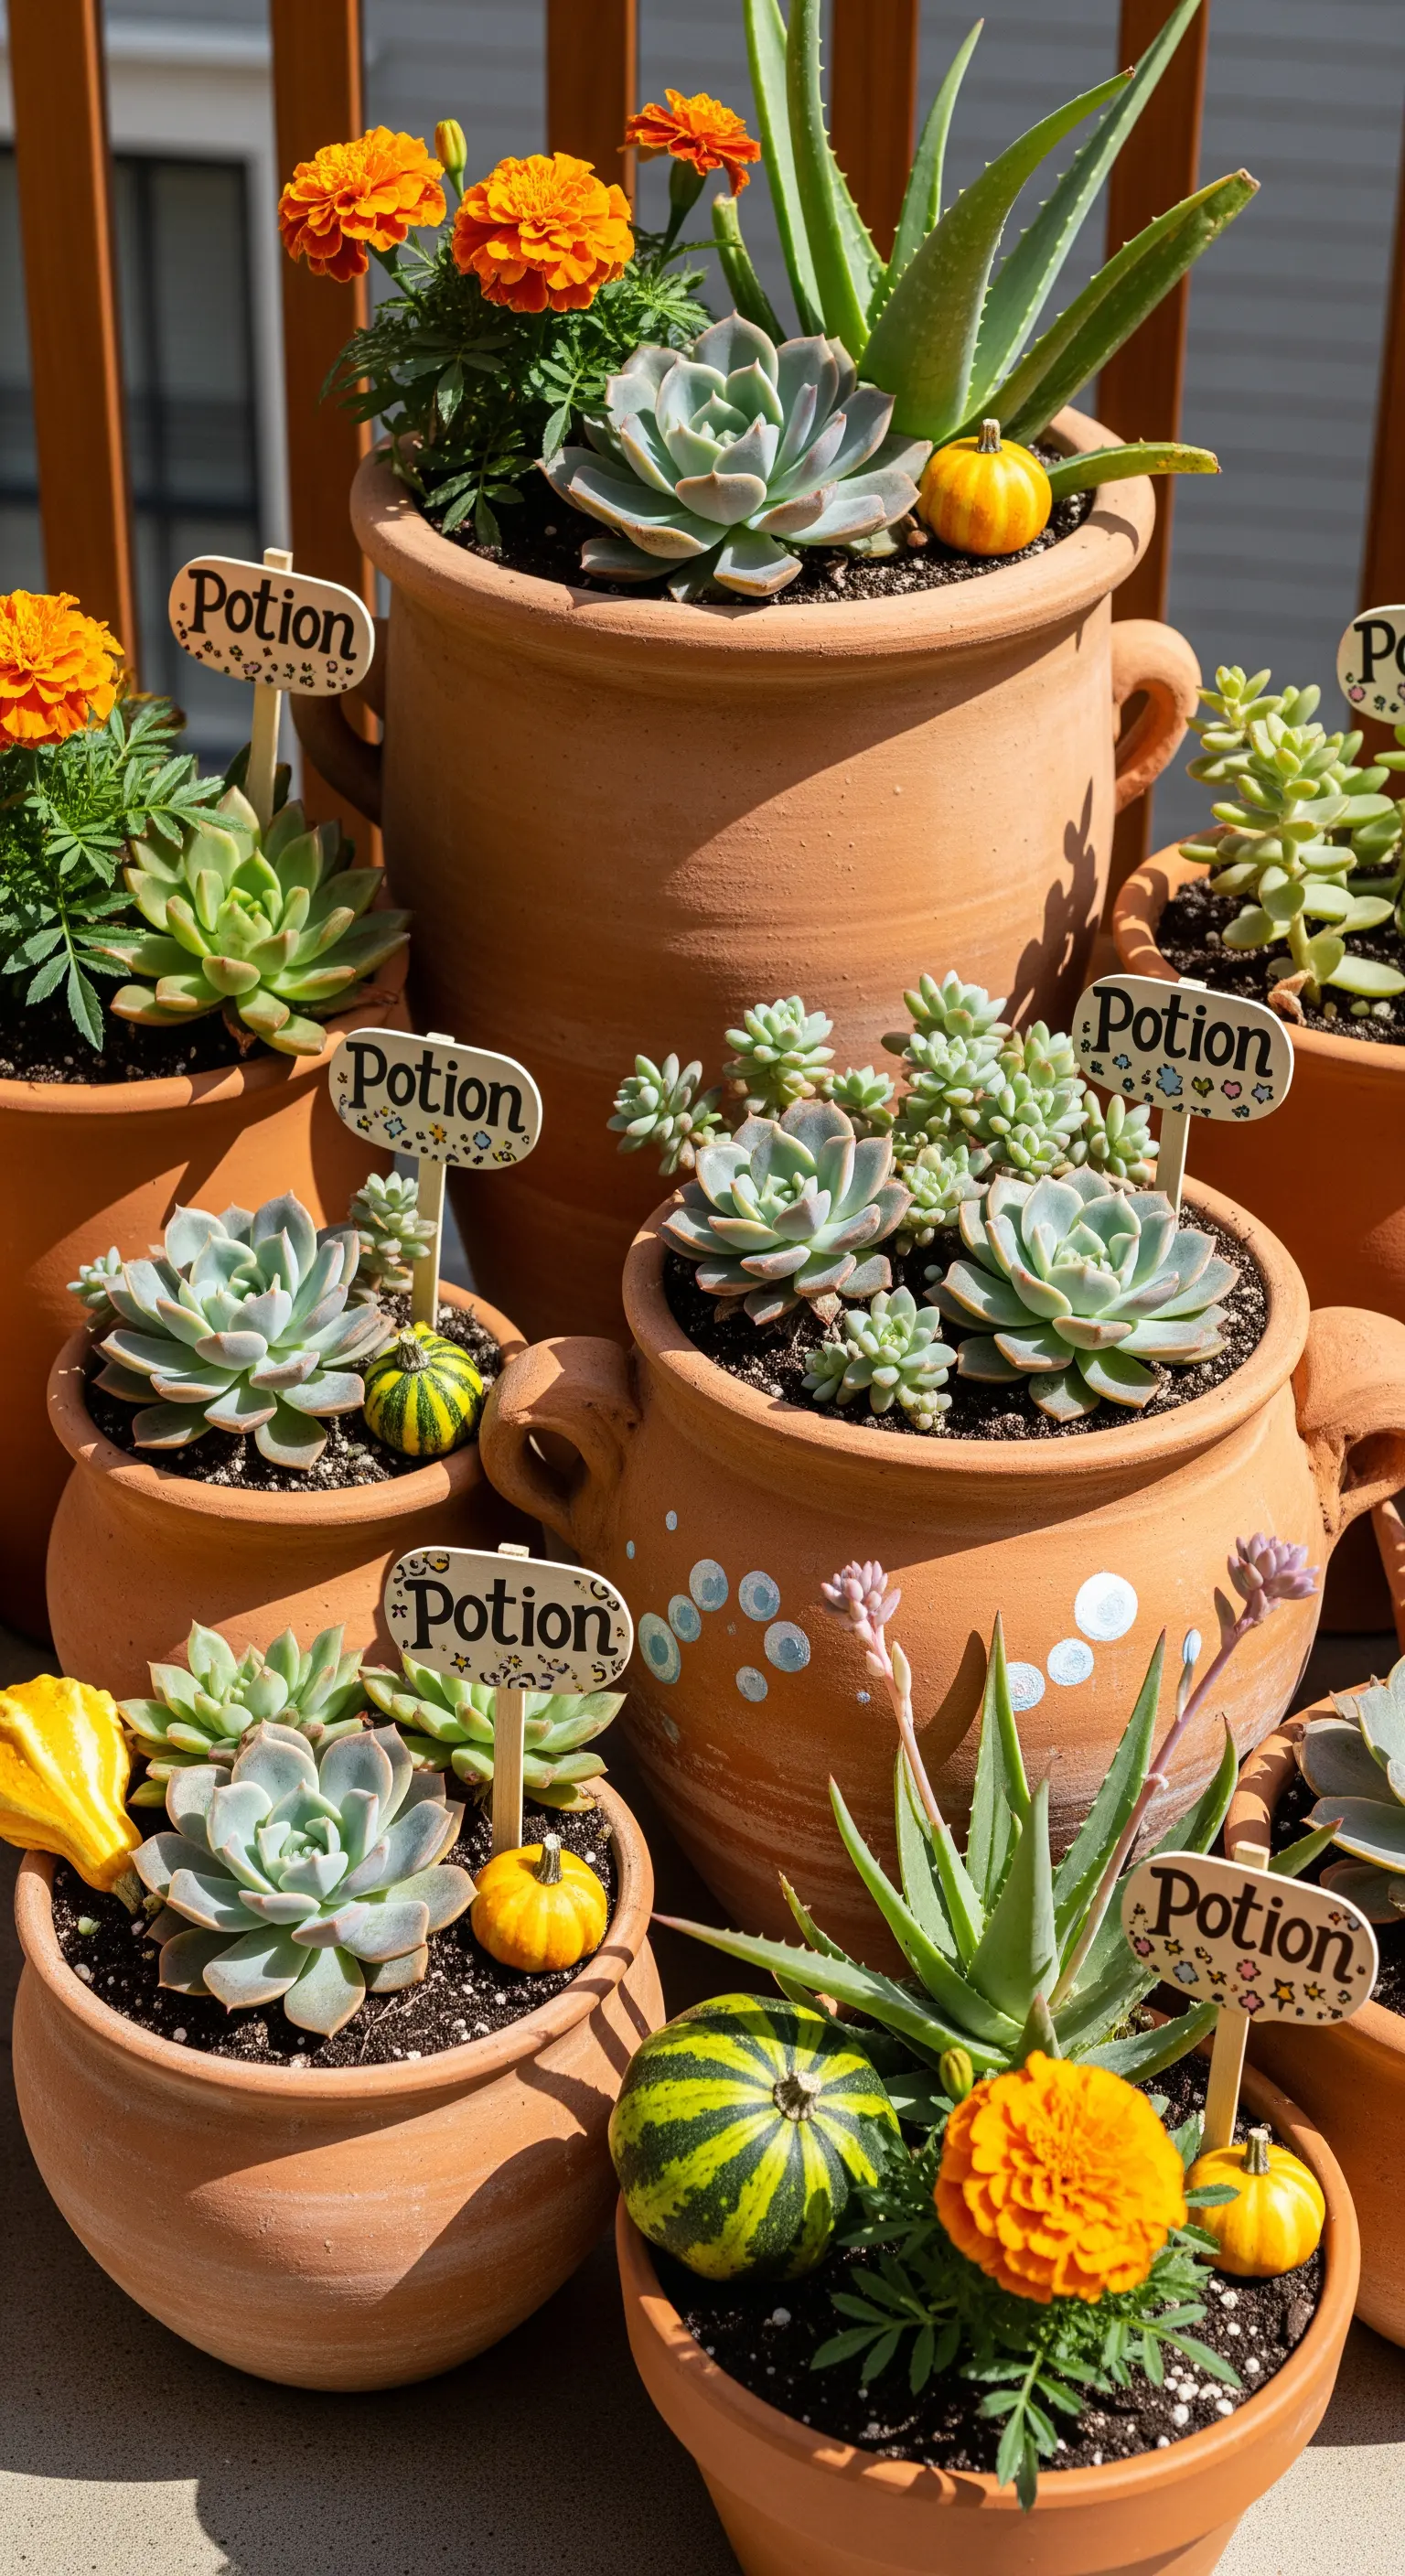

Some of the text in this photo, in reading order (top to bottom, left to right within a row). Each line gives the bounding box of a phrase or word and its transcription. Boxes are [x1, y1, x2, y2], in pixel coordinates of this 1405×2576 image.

[188, 569, 357, 661] Potion
[1089, 985, 1272, 1078] Potion
[346, 1041, 525, 1133] Potion
[403, 1578, 618, 1657] Potion
[1147, 1867, 1354, 1983] Potion
